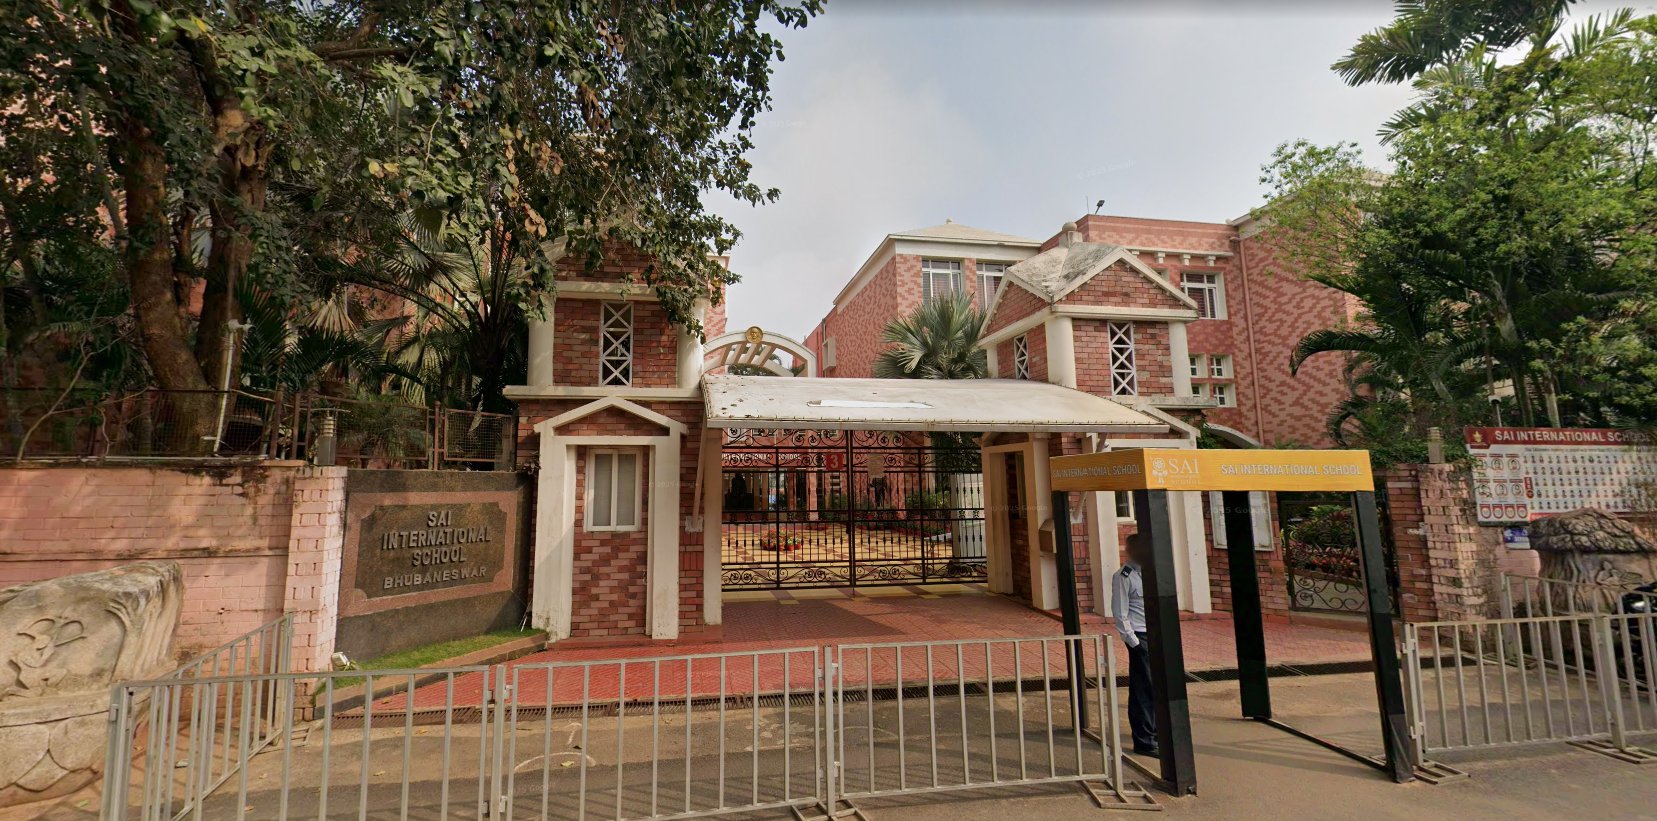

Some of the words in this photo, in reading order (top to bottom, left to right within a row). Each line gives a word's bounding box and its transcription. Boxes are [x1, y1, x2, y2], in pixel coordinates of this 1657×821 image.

[1495, 430, 1514, 441] SAI
[1517, 431, 1606, 441] INTERNATIONAL
[1607, 431, 1651, 442] SCHOOL
[830, 455, 839, 468] 3
[1167, 458, 1200, 474] SAI
[1221, 464, 1238, 475] SAI
[1240, 464, 1320, 475] INTERNATIONAL
[1322, 464, 1362, 475] SCHOOL
[1063, 466, 1112, 477] INTERNATIONAL
[1113, 464, 1141, 475] SCHOOL
[427, 510, 451, 527] SAI
[382, 526, 491, 549] INTERNATIONAL
[412, 547, 467, 567] SCHOOL
[384, 566, 486, 588] BHUBANESWAR
